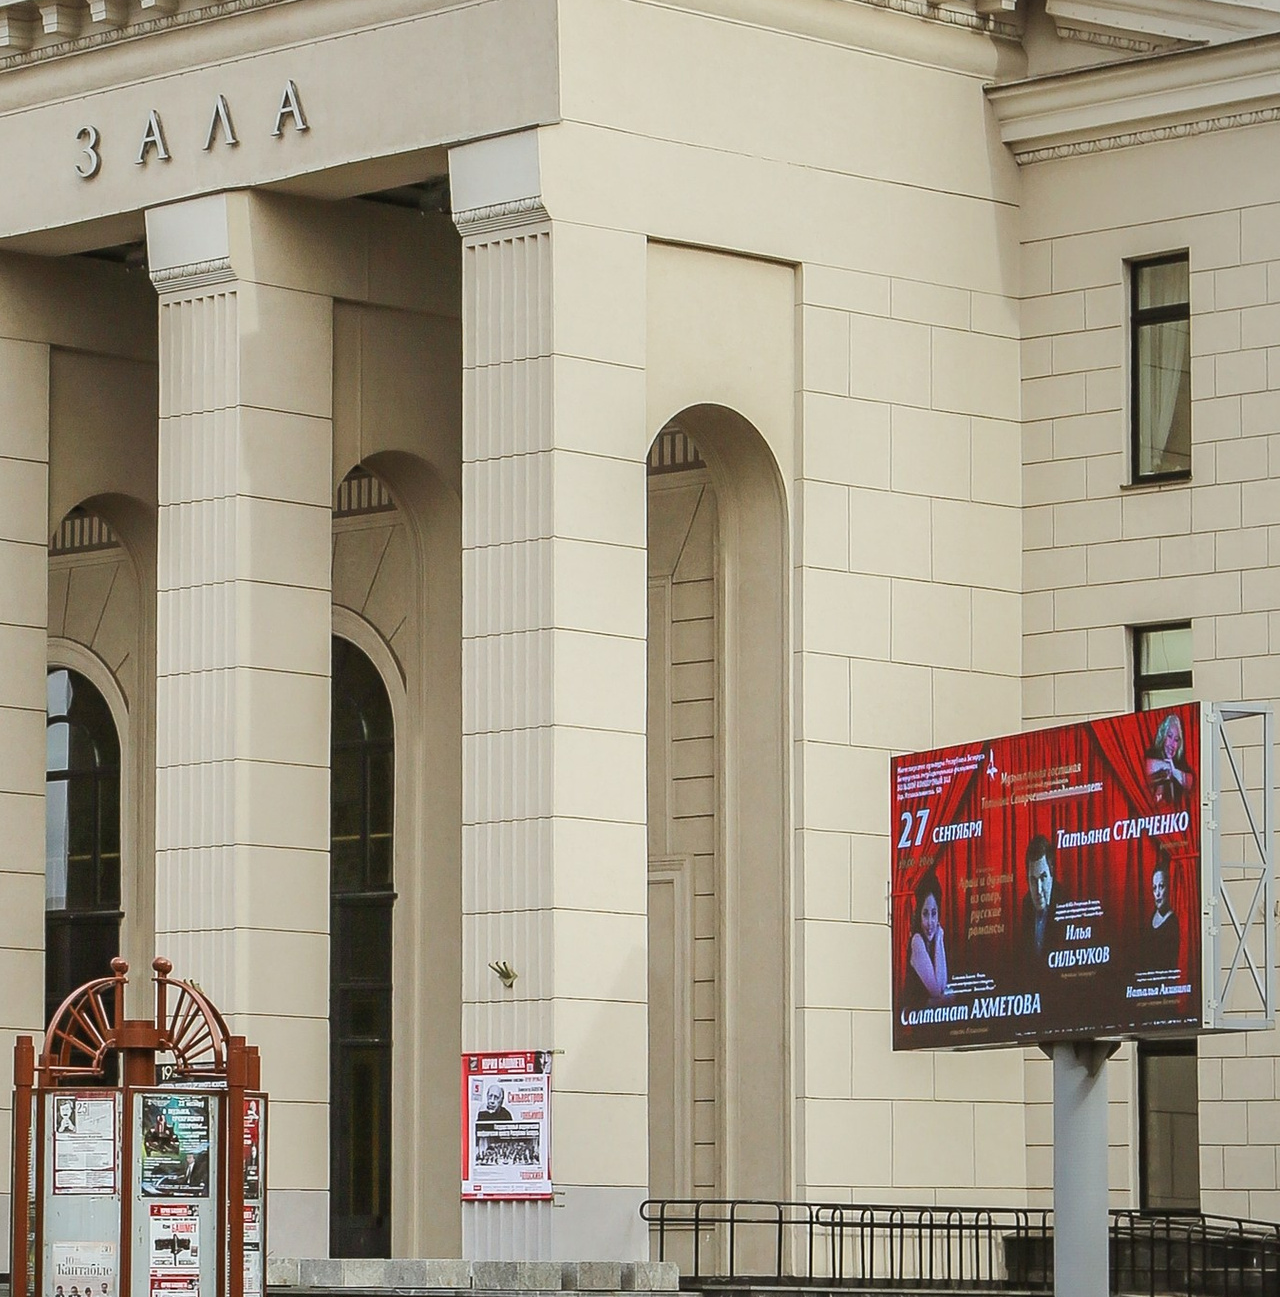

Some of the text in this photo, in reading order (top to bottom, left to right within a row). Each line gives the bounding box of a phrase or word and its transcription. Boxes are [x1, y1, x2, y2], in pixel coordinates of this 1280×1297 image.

[73, 78, 312, 179] ЗАЛА
[897, 808, 983, 849] 27 СЕНТЯБРЯ
[1057, 810, 1190, 849] Татьяна СТАРЧЕНКО
[1065, 924, 1092, 941] Илья
[1047, 946, 1111, 969] СИЛЬЧУКОВ
[900, 993, 1042, 1026] Салтанат АХМЕТОВА
[161, 1065, 173, 1080] 19
[76, 1102, 88, 1114] 25
